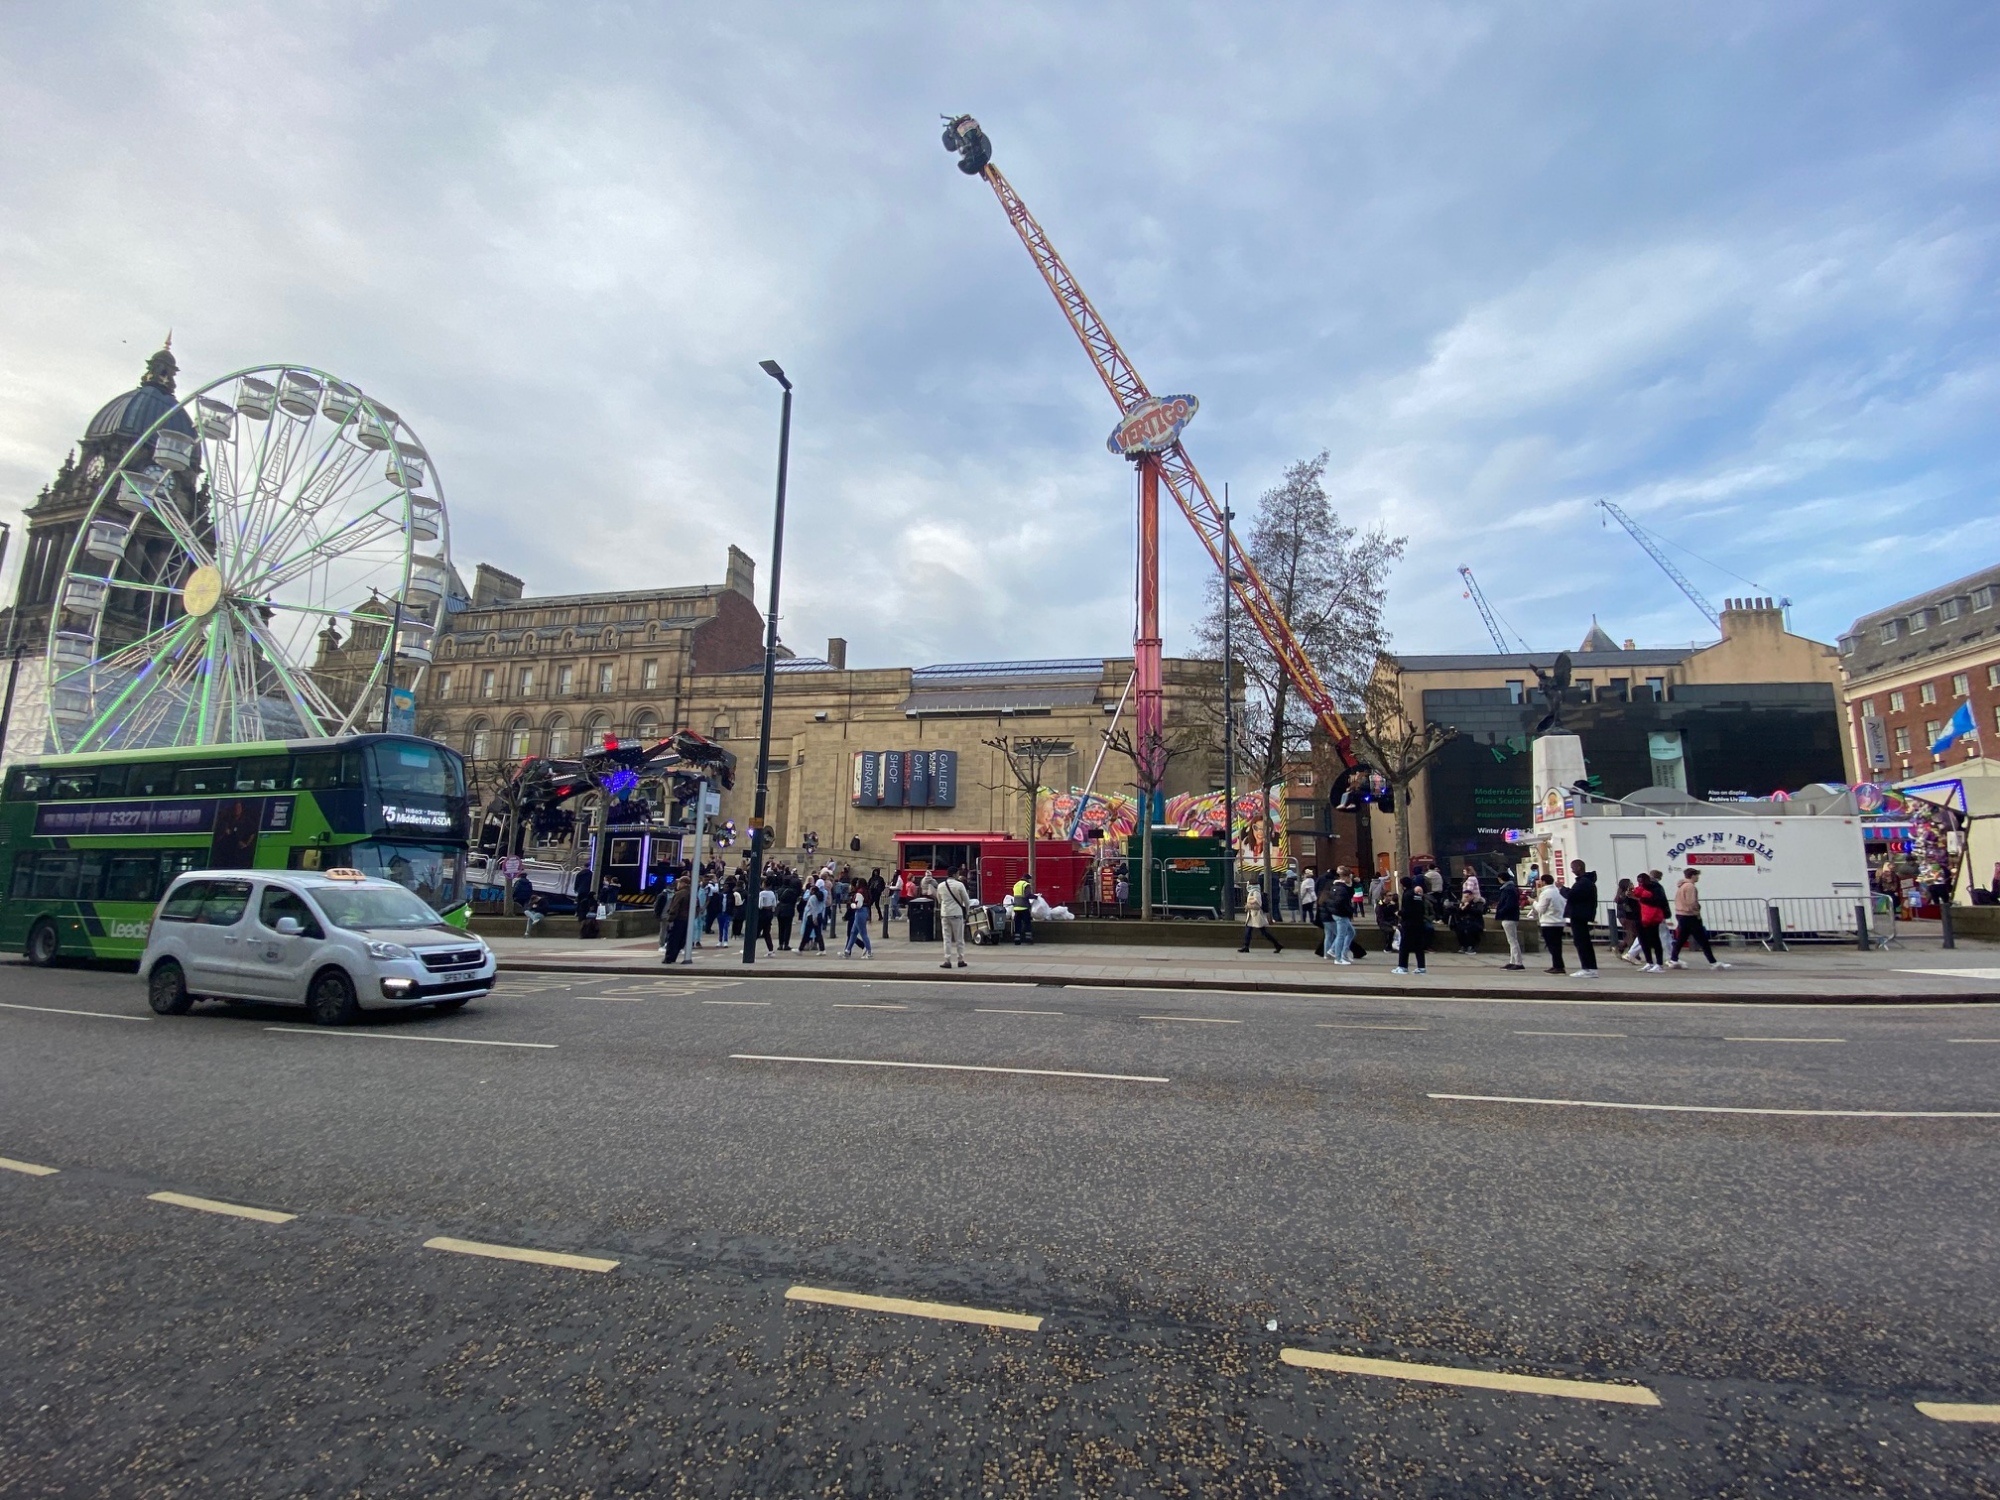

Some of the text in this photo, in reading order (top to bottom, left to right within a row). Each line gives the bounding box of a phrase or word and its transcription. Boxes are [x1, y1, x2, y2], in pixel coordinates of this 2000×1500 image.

[1115, 399, 1189, 450] VERTIGO
[863, 754, 874, 797] LIBRARY
[889, 754, 899, 784] SHOP
[913, 754, 923, 782] CAFE
[938, 753, 949, 800] GALLERY
[1475, 787, 1505, 795] Modern
[109, 810, 142, 827] £327
[382, 805, 397, 822] 75
[396, 813, 452, 827] Middleton ASDA
[1667, 834, 1706, 861] ROCK
[1735, 834, 1774, 861] ROLL
[333, 869, 363, 877] TAXI
